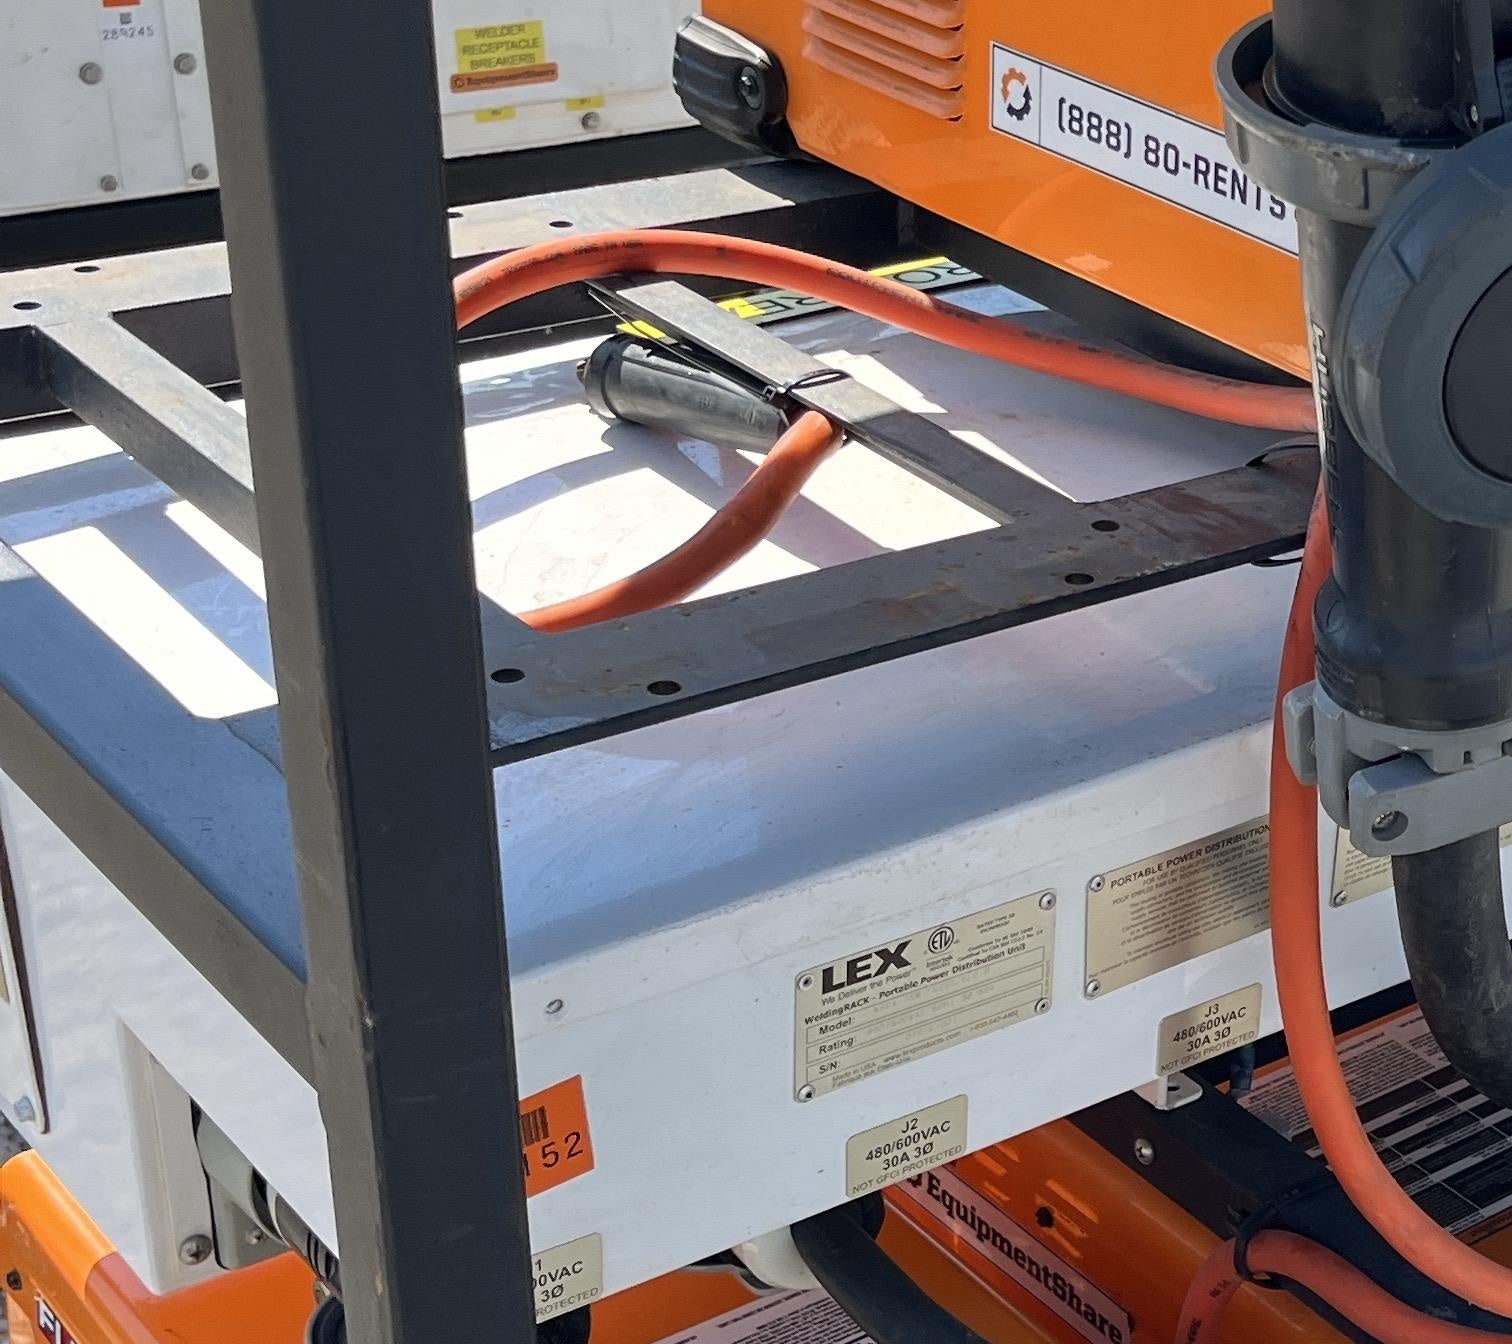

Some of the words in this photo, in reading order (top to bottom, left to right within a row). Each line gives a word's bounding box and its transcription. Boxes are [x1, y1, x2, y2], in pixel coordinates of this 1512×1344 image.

[1058, 97, 1132, 159] (888)
[1110, 862, 1164, 890] PORTABLE
[1166, 848, 1202, 870] POWER
[822, 939, 912, 995] LEX
[804, 996, 871, 1025] WeldingRACK
[878, 980, 920, 1000] Portable
[921, 969, 950, 986] Power
[951, 951, 1006, 975] Distribution
[1007, 942, 1027, 956] Unit
[838, 985, 868, 1003] Deliver
[1204, 1003, 1220, 1018] J3
[819, 1016, 856, 1035] Model:
[1173, 1006, 1247, 1043] 480/600VAC
[819, 1036, 858, 1056] Rating:
[1186, 1034, 1211, 1053] 30A
[1203, 1030, 1255, 1057] PROTECTED
[901, 1117, 919, 1134] J2
[865, 1120, 951, 1162] 480/600VAC
[852, 1179, 874, 1195] NOT
[876, 1168, 900, 1185] GFCI
[902, 1144, 963, 1174] PROTECTED
[882, 1151, 911, 1171] 30A
